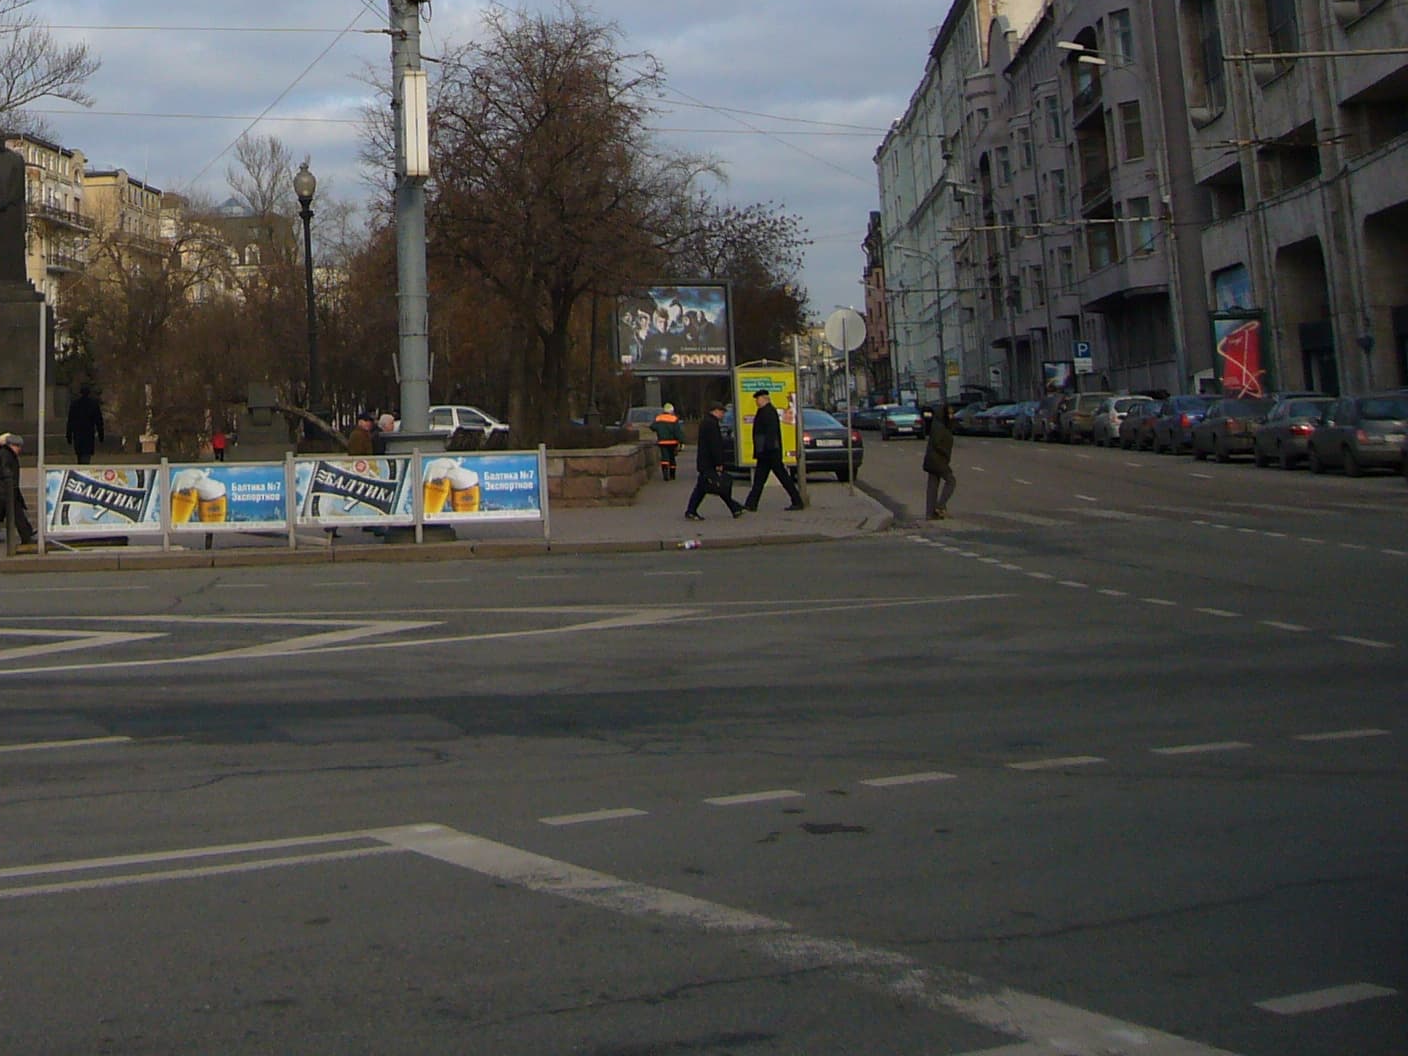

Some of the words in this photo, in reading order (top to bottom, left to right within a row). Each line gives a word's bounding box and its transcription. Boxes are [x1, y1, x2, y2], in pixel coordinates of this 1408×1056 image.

[230, 481, 266, 492] Балтика
[483, 471, 519, 482] Балтика
[74, 480, 144, 512] БАЛТИКА
[325, 471, 395, 504] БАЛТИКА
